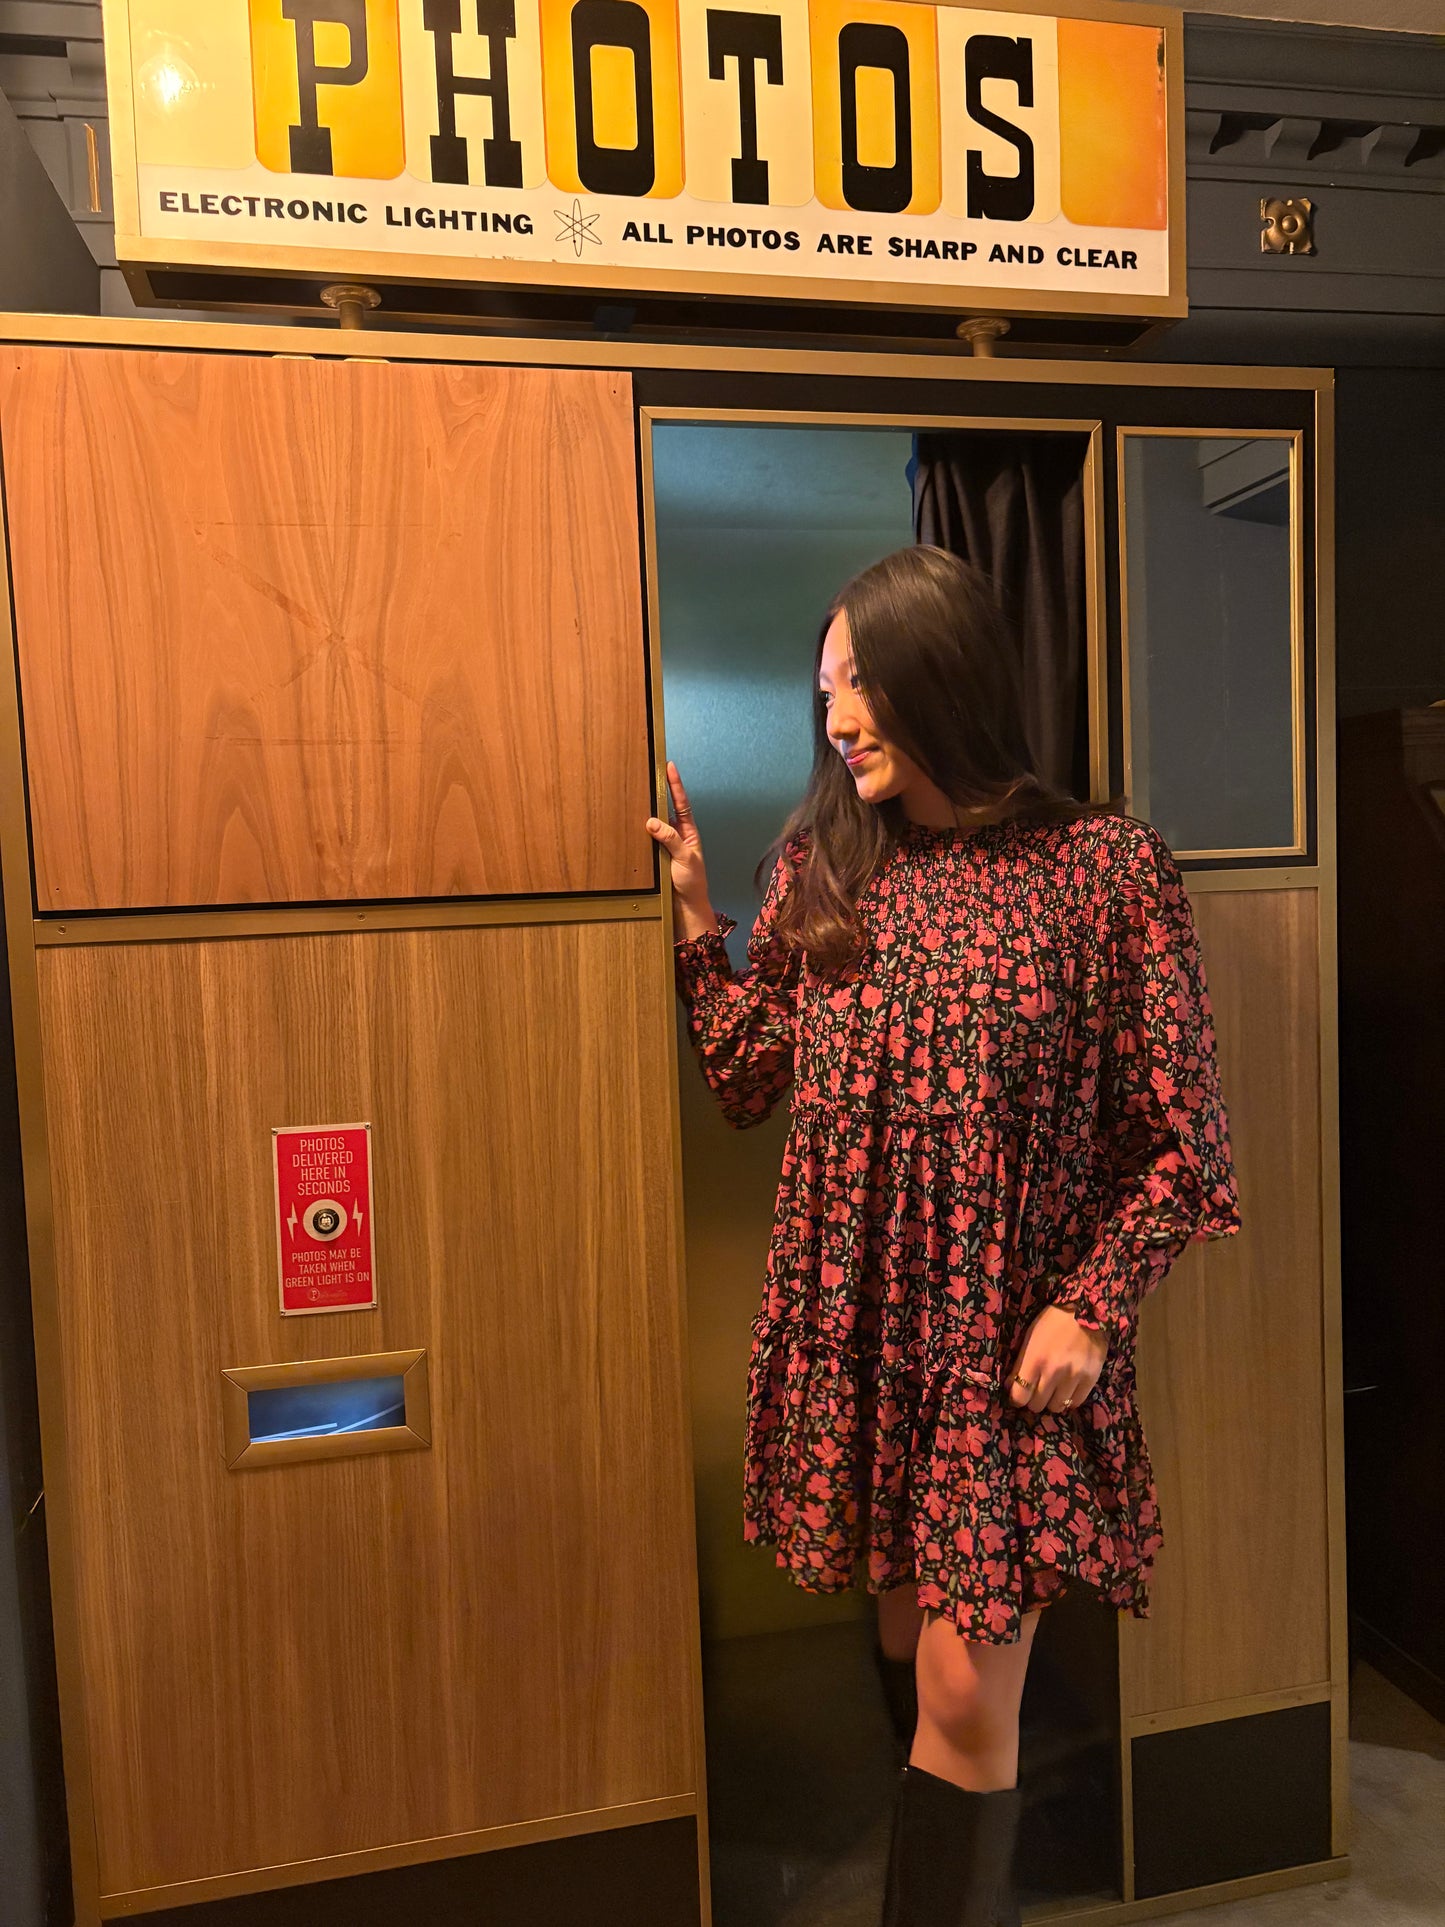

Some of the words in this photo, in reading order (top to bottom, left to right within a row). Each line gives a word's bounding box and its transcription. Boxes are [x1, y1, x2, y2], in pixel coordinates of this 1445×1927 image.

[281, 0, 1035, 222] PHOTOS
[159, 191, 368, 224] ELECTRONIC
[385, 205, 534, 235] LIGHTING
[622, 221, 673, 244] ALL
[686, 226, 801, 250] PHOTOS
[816, 233, 873, 255] ARE
[887, 236, 977, 261] SHARP
[988, 243, 1044, 264] AND
[1056, 247, 1138, 270] CLEAR
[300, 1136, 345, 1152] PHOTOS
[292, 1150, 353, 1167] DELIVERED
[301, 1166, 330, 1181] HERE
[334, 1165, 346, 1179] IN
[297, 1179, 351, 1196] SECONDS
[292, 1250, 327, 1263] PHOTOS
[329, 1249, 347, 1260] MAY
[350, 1248, 361, 1259] BE
[299, 1263, 327, 1275] TAKEN
[329, 1261, 355, 1272] WHEN
[285, 1276, 314, 1288] GREEN
[317, 1273, 342, 1286] LIGHT
[345, 1272, 354, 1283] IS
[357, 1271, 370, 1282] ON
